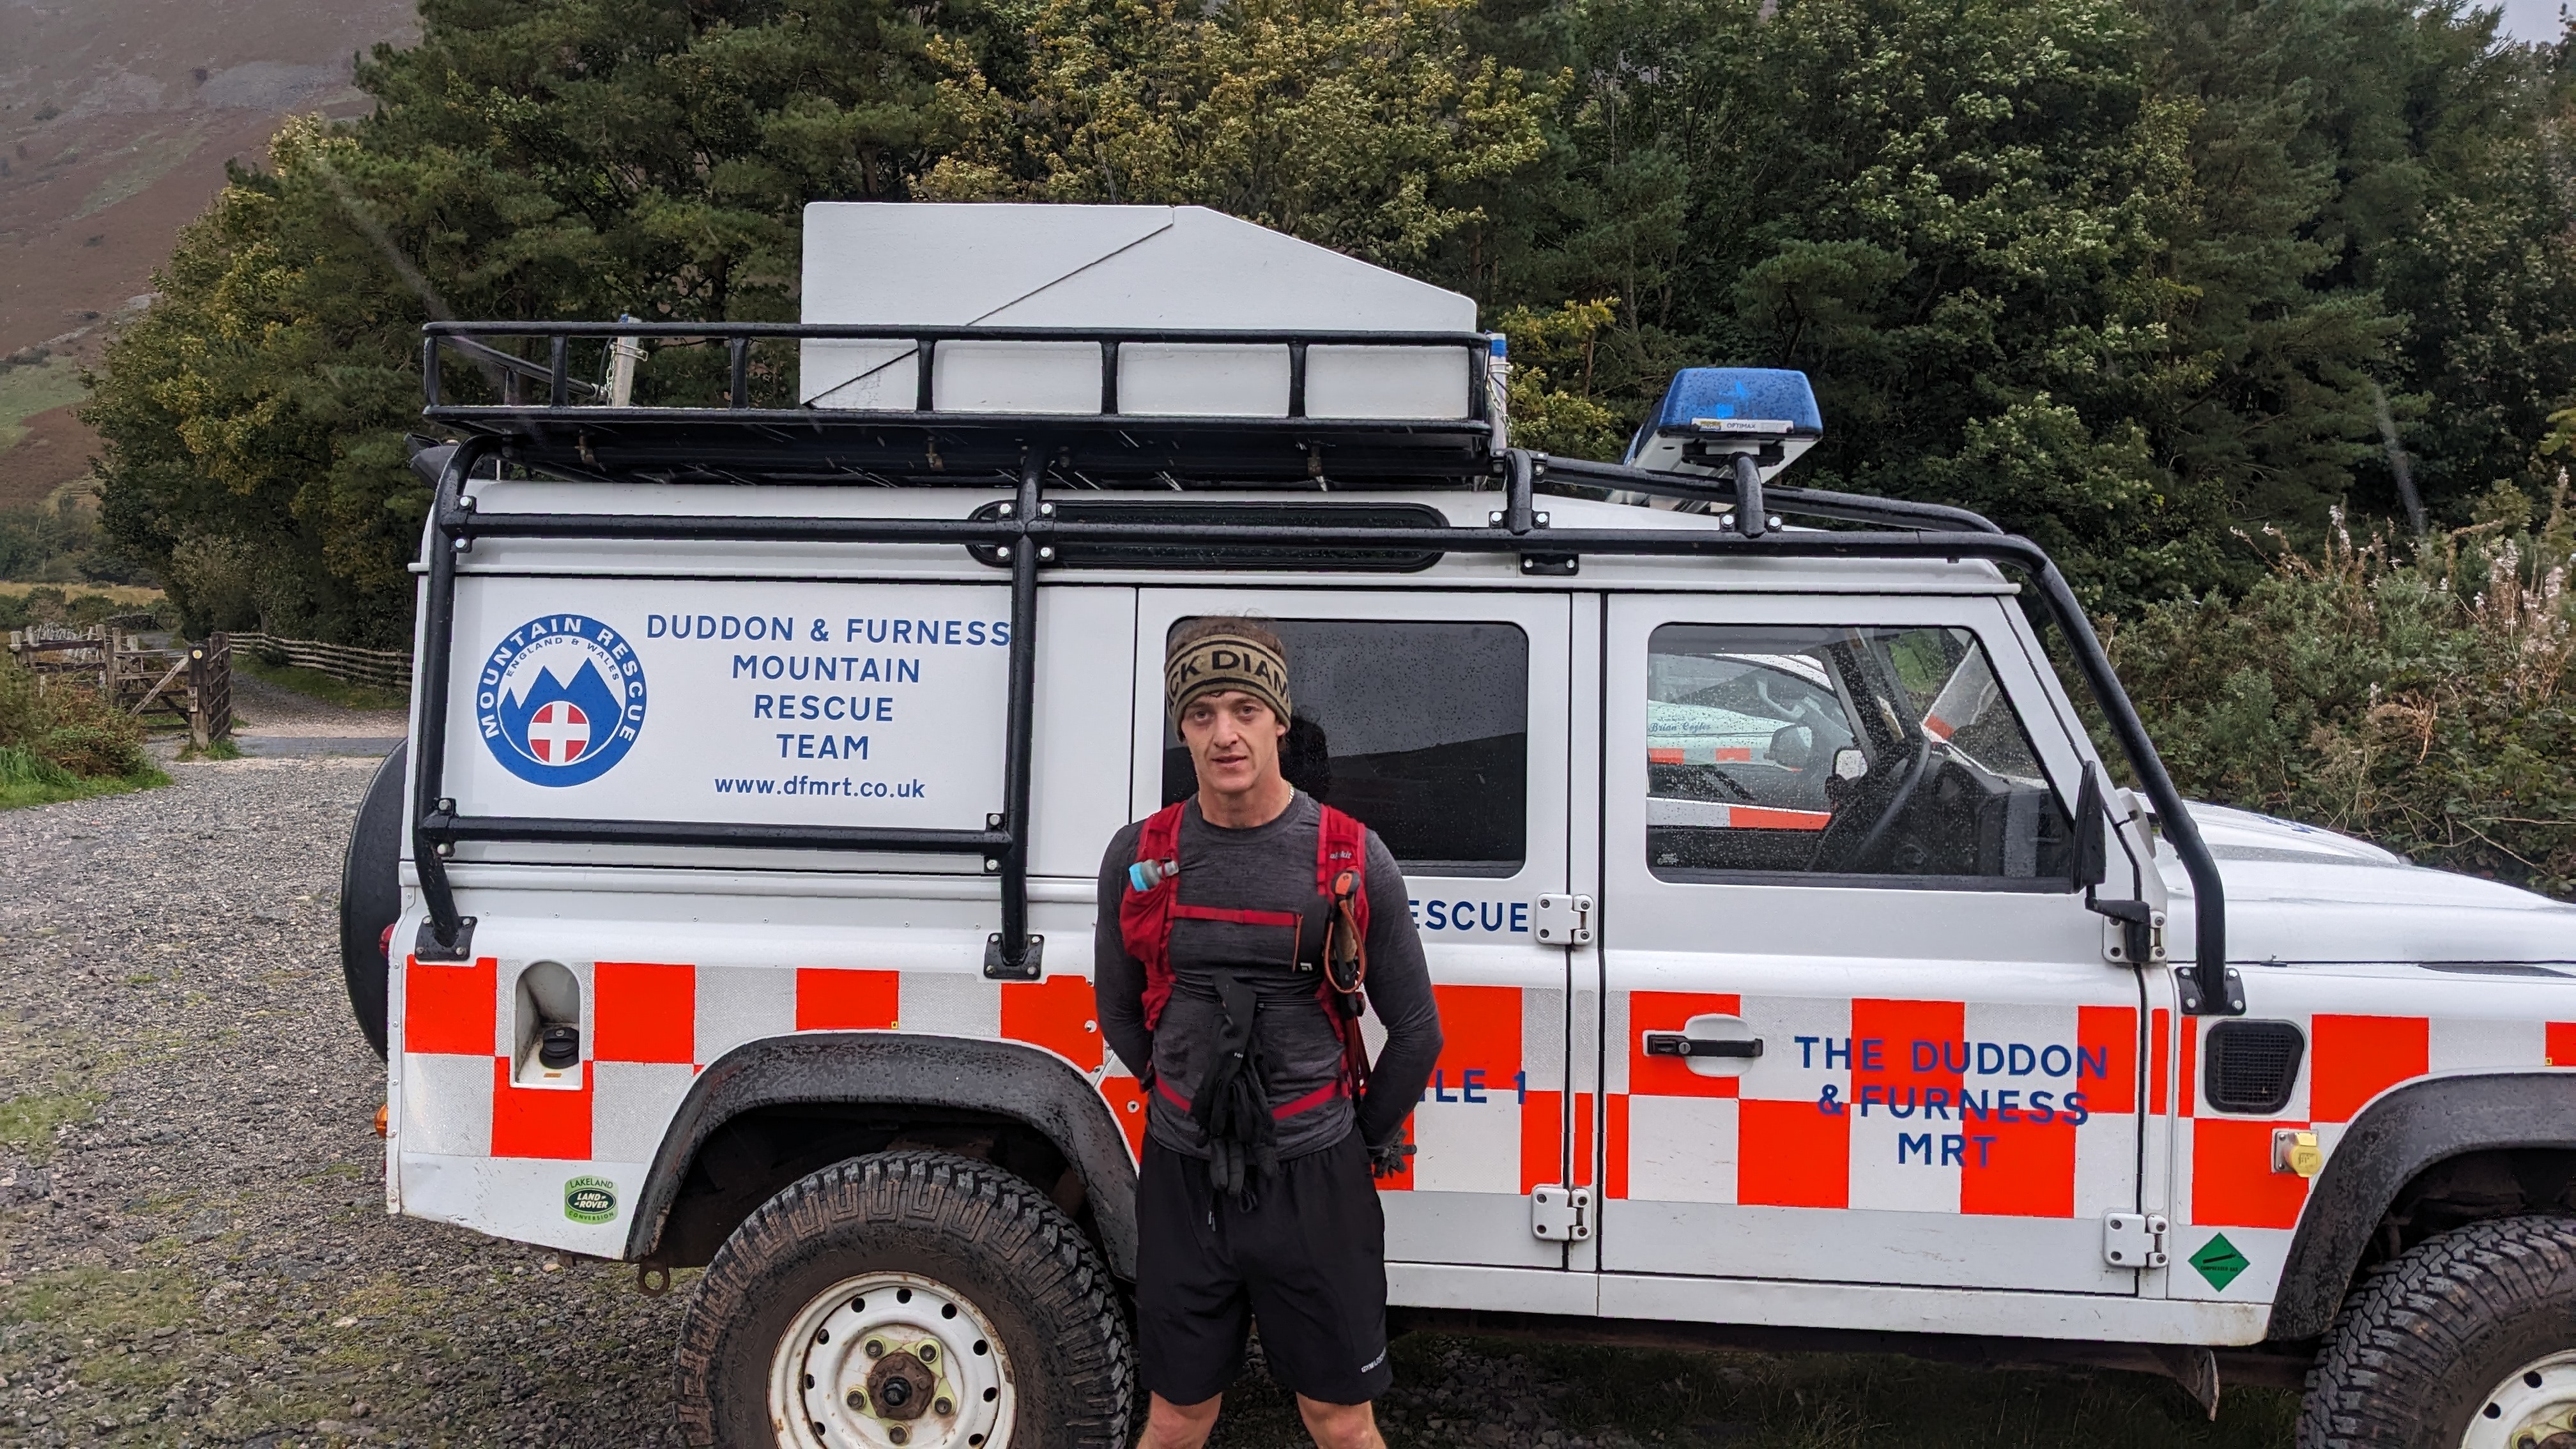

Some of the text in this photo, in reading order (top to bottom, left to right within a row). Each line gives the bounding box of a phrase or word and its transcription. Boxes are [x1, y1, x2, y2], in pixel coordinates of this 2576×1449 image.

[648, 615, 1009, 646] DUDDON & FURNESS
[506, 637, 563, 677] ENGLAND
[587, 643, 619, 680] WALES
[733, 656, 921, 683] MOUNTAIN
[480, 618, 643, 742] MOUNTAIN RESCUE
[755, 694, 893, 721] RESCUE
[776, 733, 868, 759] TEAM
[714, 775, 924, 798] www.dfmrt.co.uk
[1794, 1036, 2107, 1079] THE DUDDON
[1416, 1069, 1526, 1105] LE 1
[1818, 1084, 2089, 1125] & FURNESS
[1898, 1133, 1997, 1168] MRT
[570, 1178, 613, 1188] LAKELAND
[577, 1193, 601, 1201] LAND
[579, 1200, 609, 1209] ROVER
[569, 1211, 614, 1221] CONVERSION
